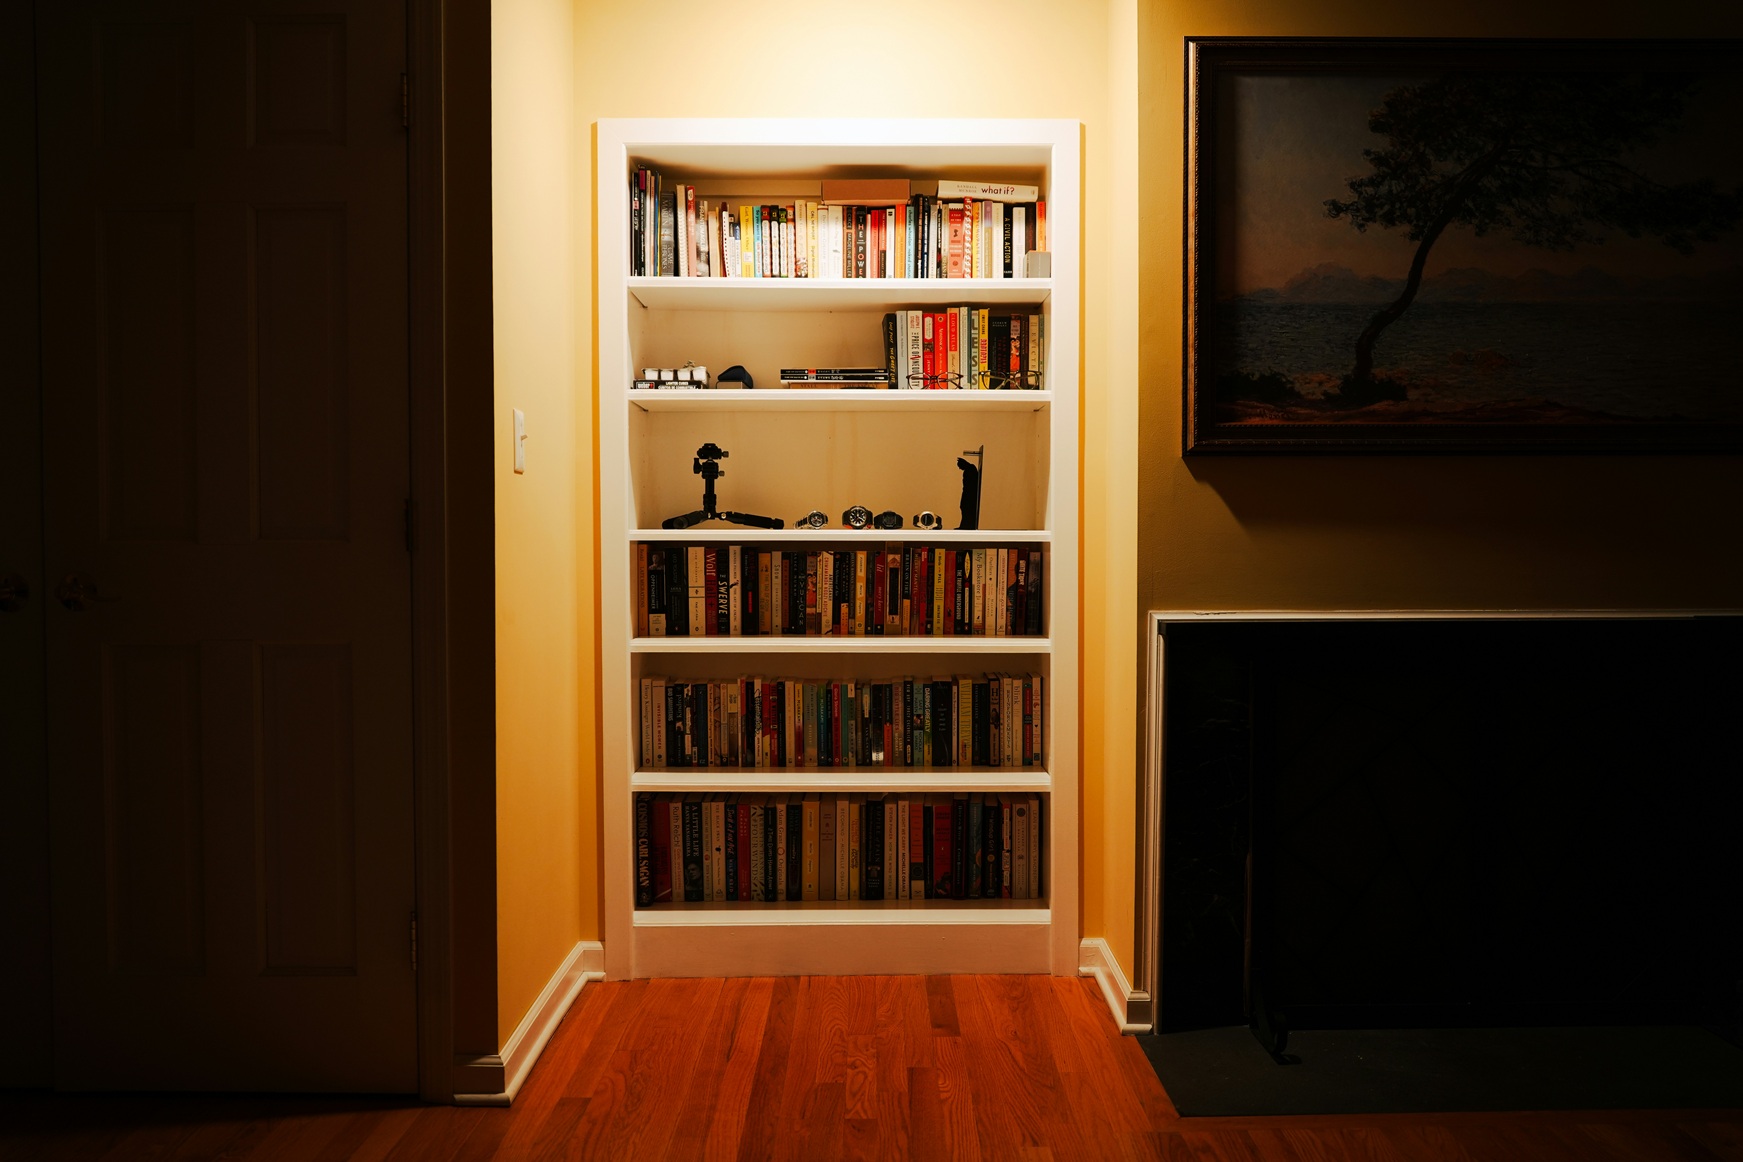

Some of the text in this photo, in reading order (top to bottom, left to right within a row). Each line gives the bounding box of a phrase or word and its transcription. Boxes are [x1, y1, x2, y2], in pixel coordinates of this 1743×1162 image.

[981, 185, 1015, 195] what if?
[706, 553, 715, 576] Wolf
[975, 553, 983, 562] My
[904, 572, 909, 580] ON
[718, 580, 727, 614] SWERVE
[638, 803, 649, 886] COSMOS CARL SAGAN
